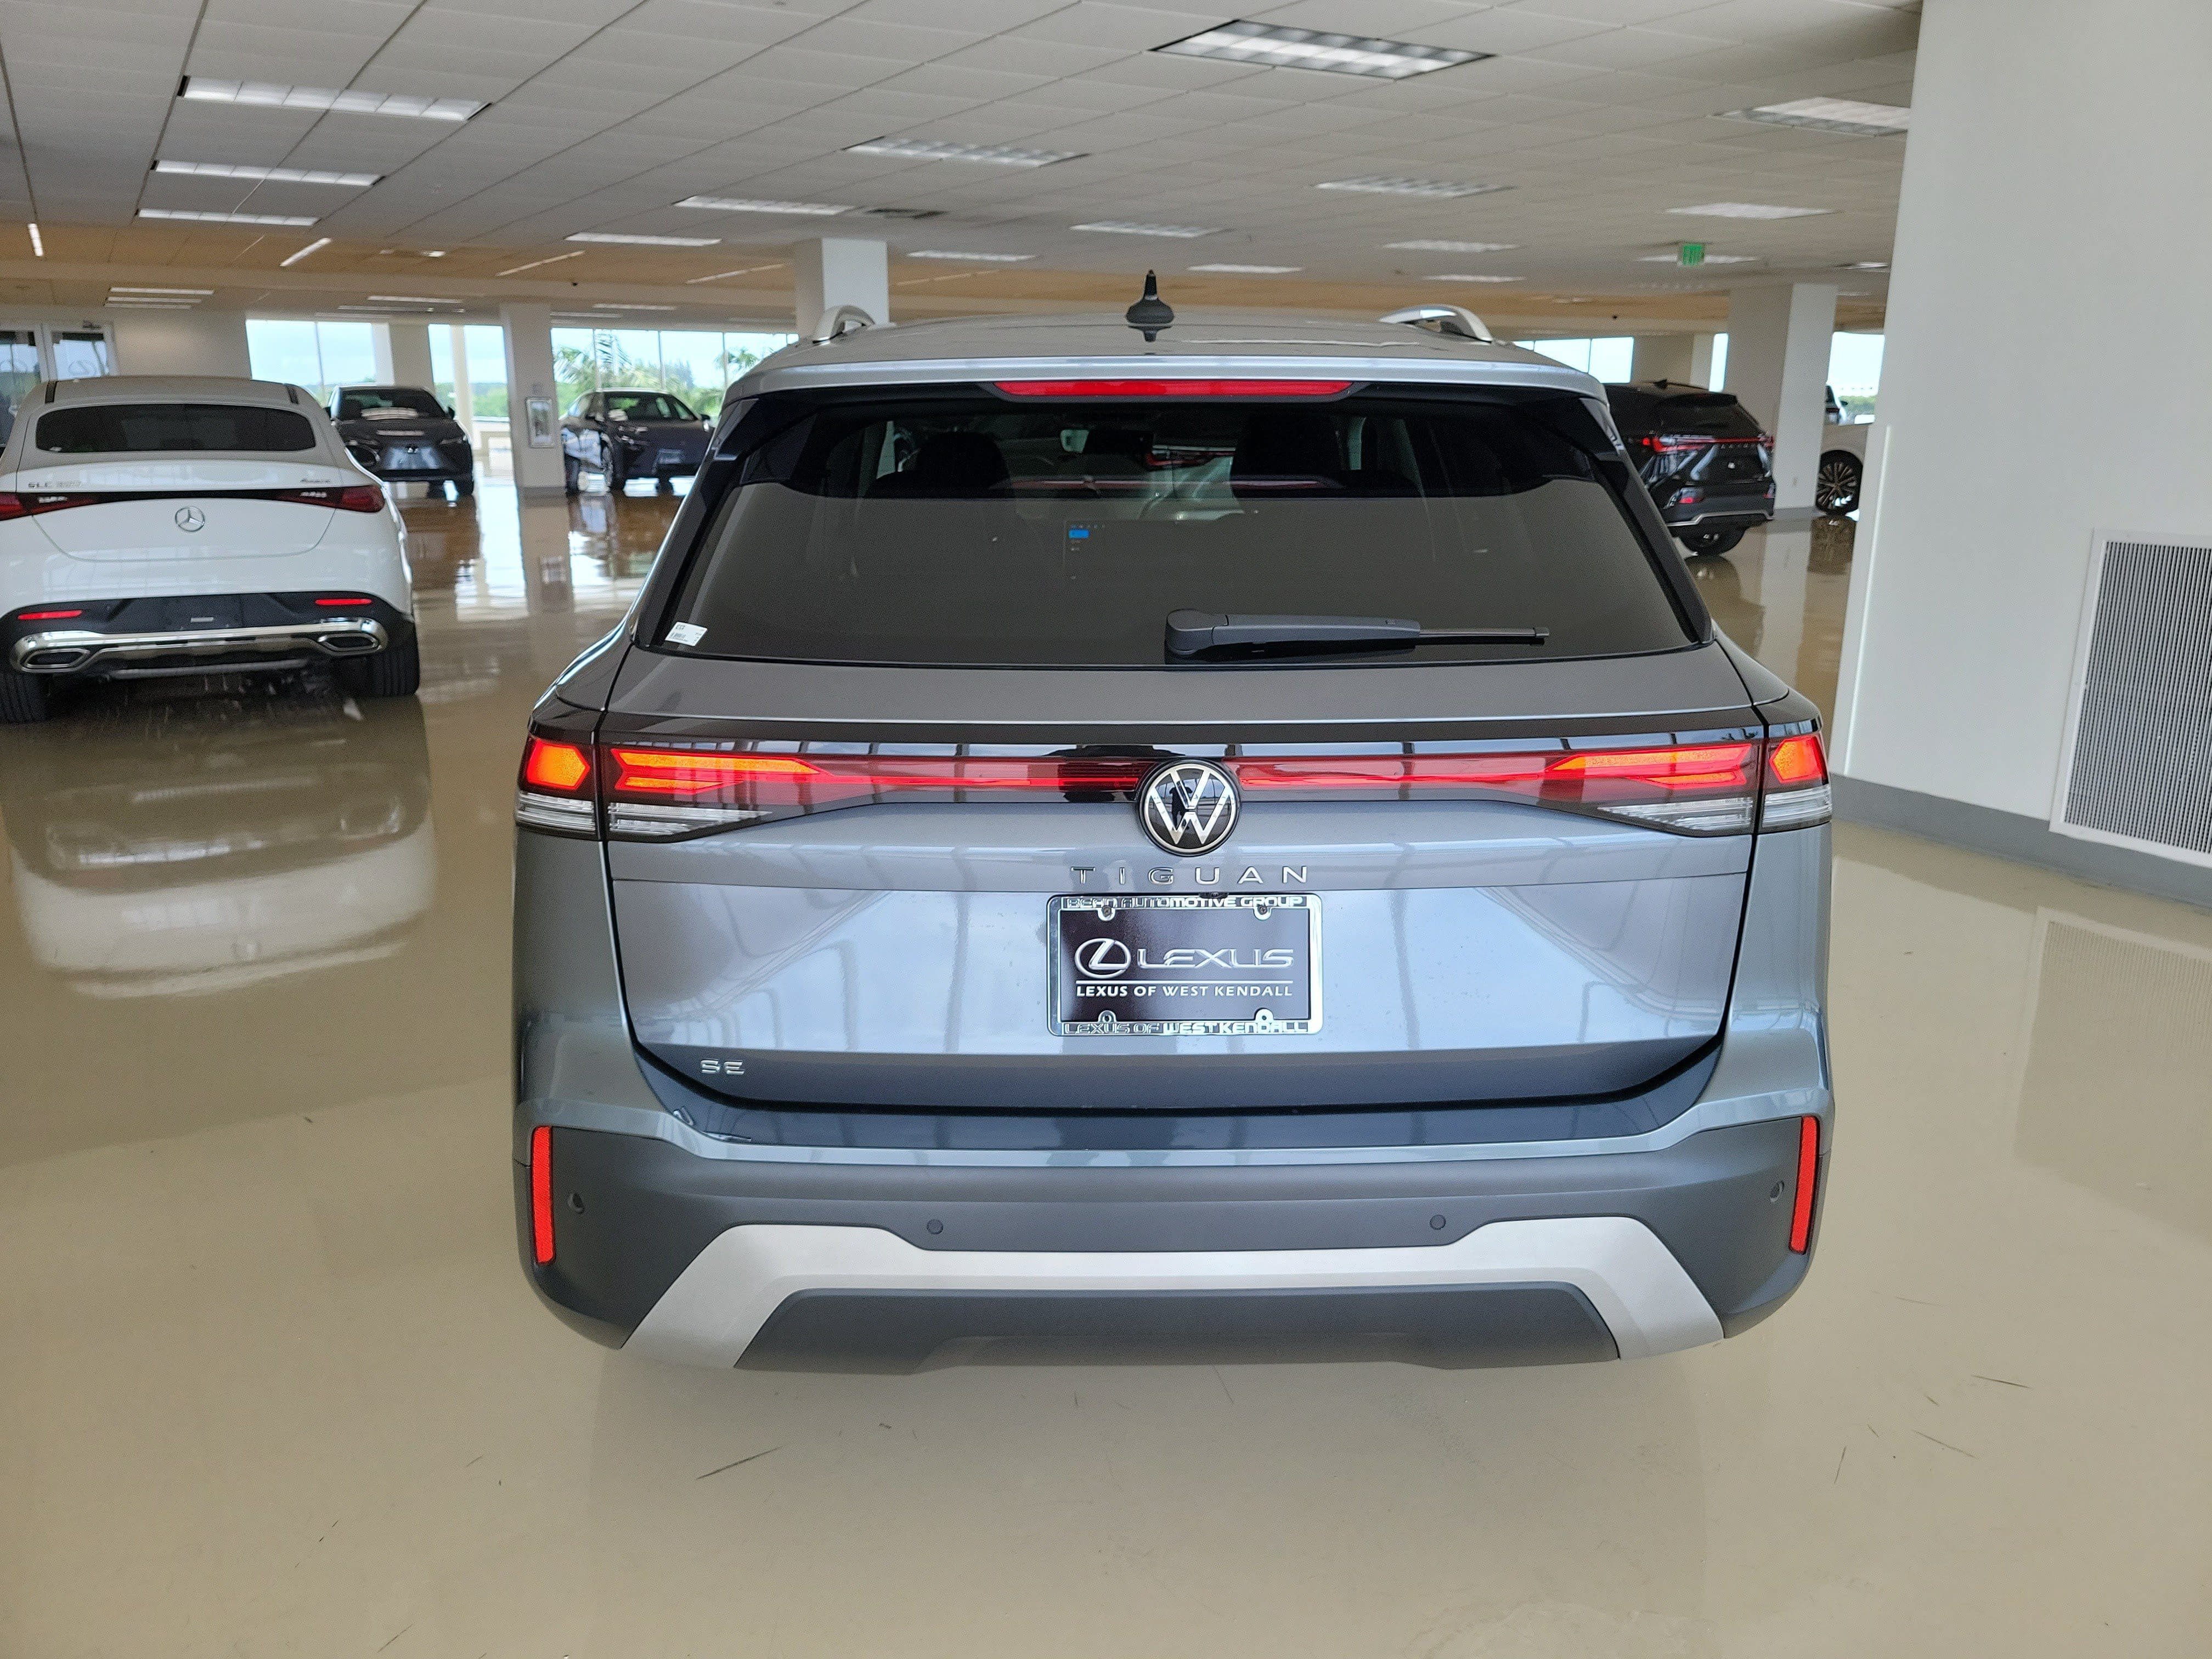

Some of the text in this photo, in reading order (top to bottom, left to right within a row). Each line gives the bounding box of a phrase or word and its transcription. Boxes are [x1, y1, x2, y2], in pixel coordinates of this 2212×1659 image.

[1071, 866, 1307, 885] TIGUAN
[1121, 896, 1237, 909] AUTOMOTIVE
[1240, 896, 1304, 907] GROUP
[1137, 948, 1294, 968] LEXUS
[1076, 985, 1293, 997] LEXUS OF WEST KENDALL
[1064, 1022, 1308, 1034] LEXUS OF WEST KENDALL
[700, 1059, 744, 1075] SE
